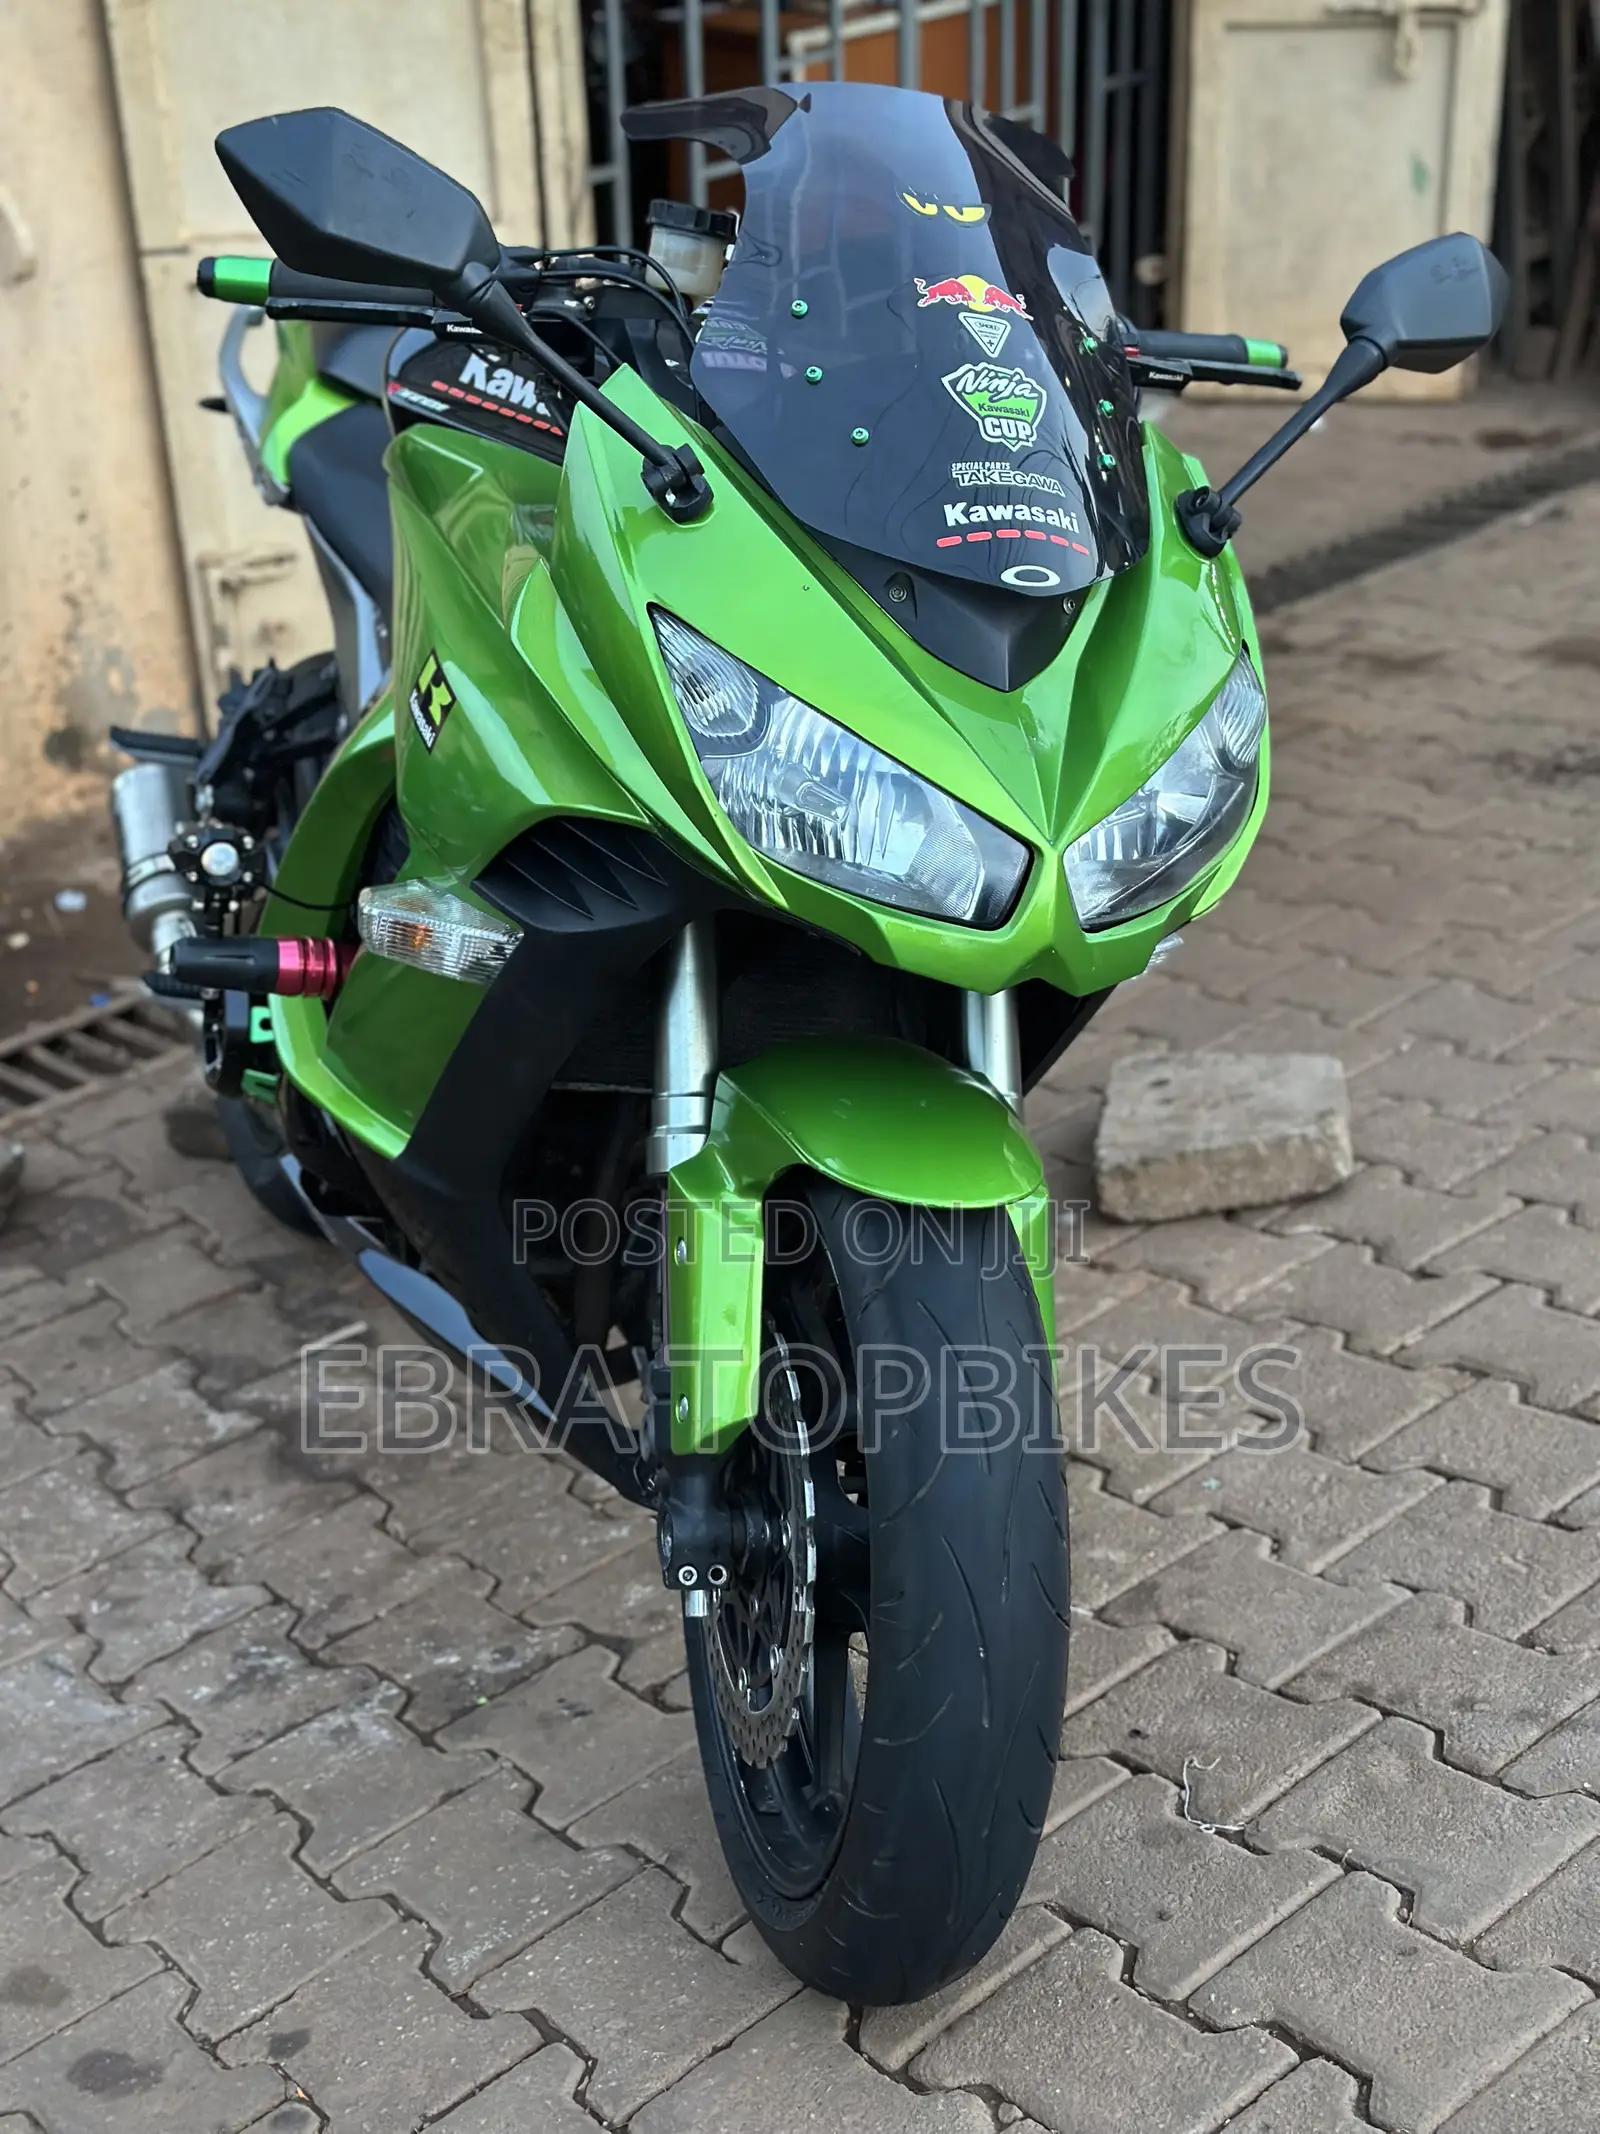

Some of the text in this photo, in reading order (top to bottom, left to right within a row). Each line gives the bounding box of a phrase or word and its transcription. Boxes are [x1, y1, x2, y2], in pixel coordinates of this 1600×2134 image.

[446, 324, 483, 334] Kawasa
[459, 348, 551, 418] Kaw
[955, 368, 1039, 401] Ninja
[978, 402, 1030, 418] Kawasaki
[983, 417, 1033, 440] CUP
[951, 461, 1011, 471] SPECIAL PARTS
[952, 470, 1066, 498] TAKEGAWA
[943, 502, 1080, 534] Kawasaki
